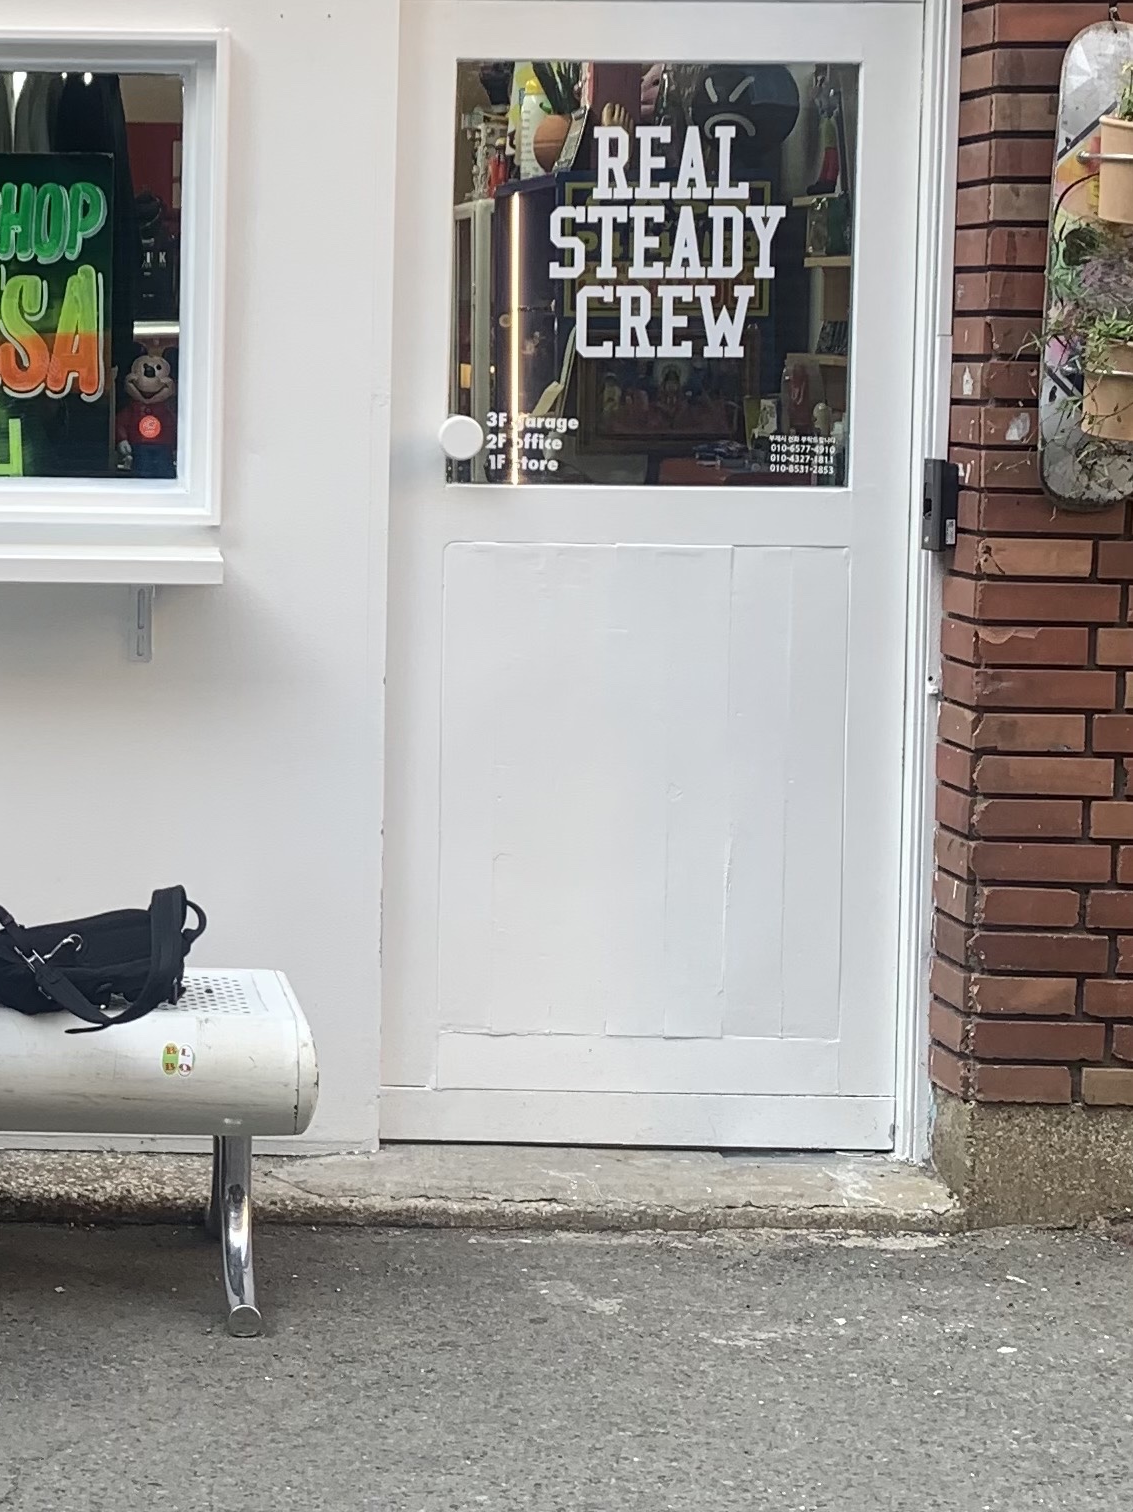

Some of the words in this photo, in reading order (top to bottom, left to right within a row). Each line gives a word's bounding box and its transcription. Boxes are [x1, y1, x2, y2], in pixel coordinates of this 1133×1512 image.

[592, 125, 750, 199] REAL
[549, 205, 786, 280] STEADY
[575, 285, 755, 358] CREW
[486, 412, 508, 428] 3F
[485, 434, 507, 450] 2F
[770, 444, 836, 455] 010-6577-4910
[488, 454, 507, 471] 1F
[770, 454, 834, 465] 010-4327-1811
